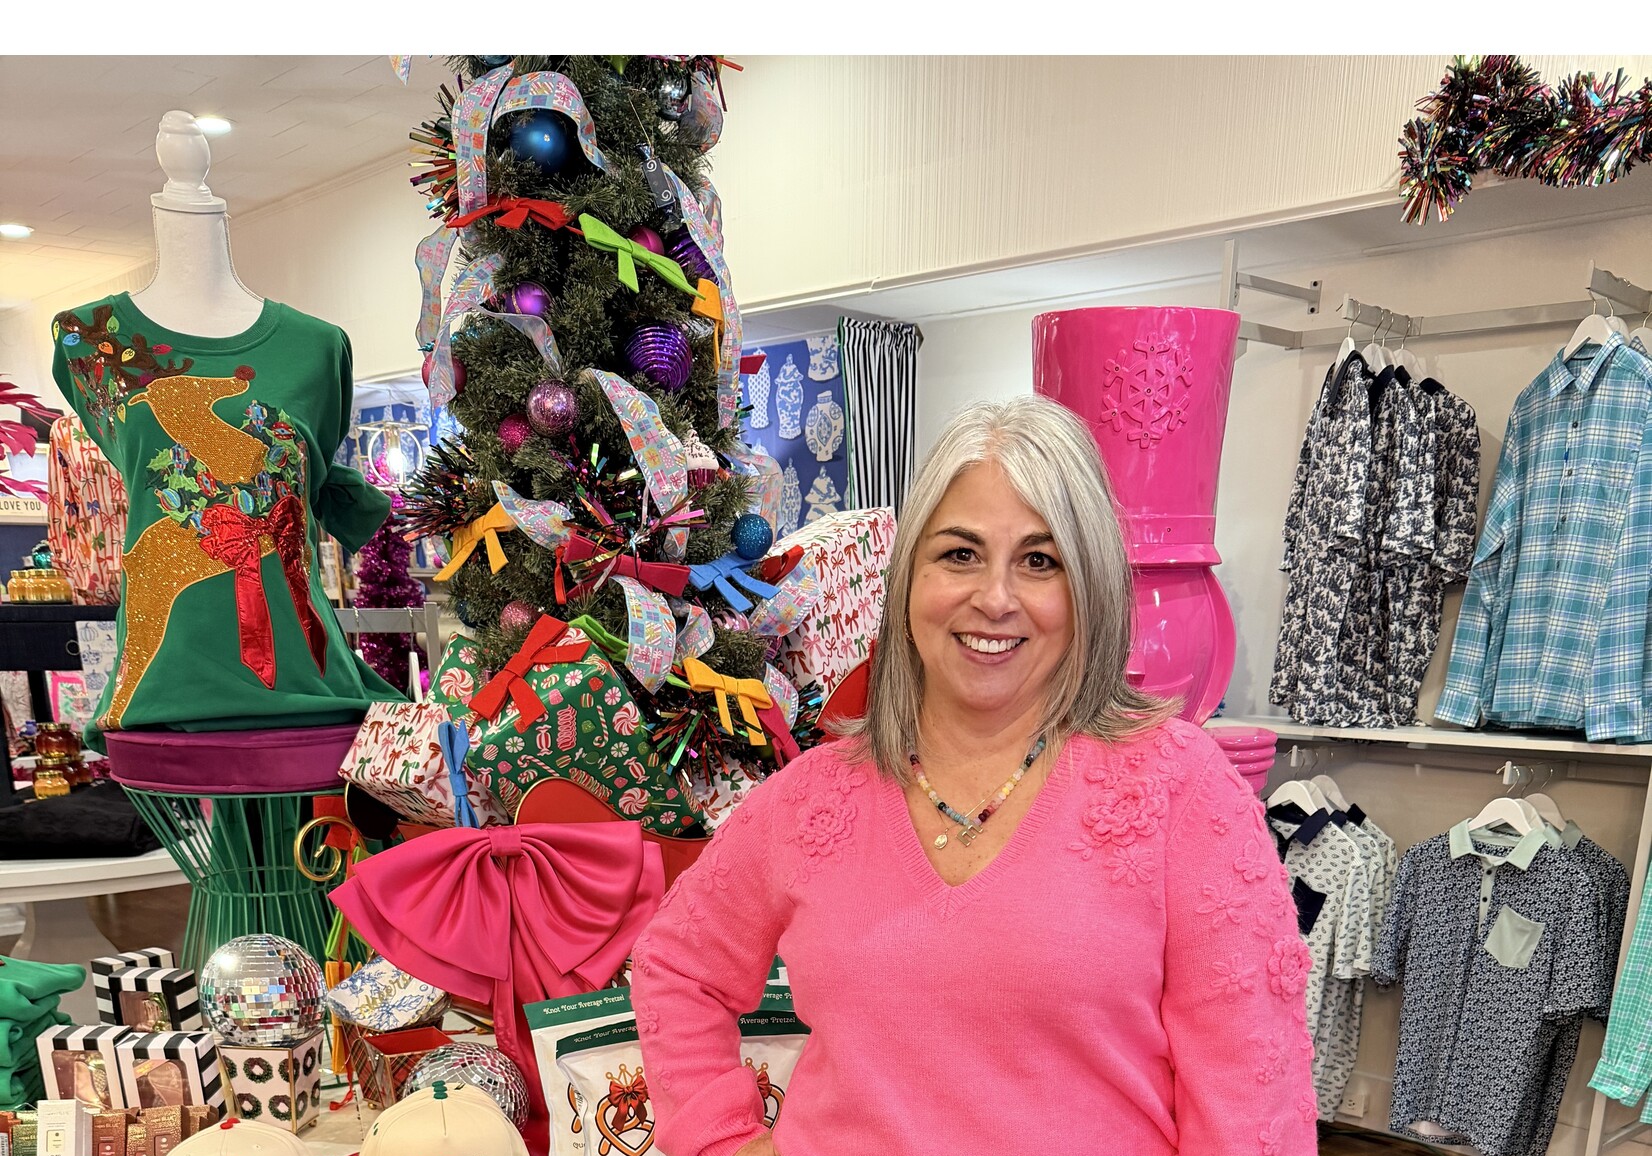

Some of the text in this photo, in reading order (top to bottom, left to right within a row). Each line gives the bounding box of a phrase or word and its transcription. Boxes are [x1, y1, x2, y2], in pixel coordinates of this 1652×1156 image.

[24, 501, 41, 511] YOU
[561, 1003, 577, 1012] Your
[578, 1000, 603, 1008] Average
[603, 994, 625, 1004] Pretzel
[612, 1026, 637, 1034] Averag
